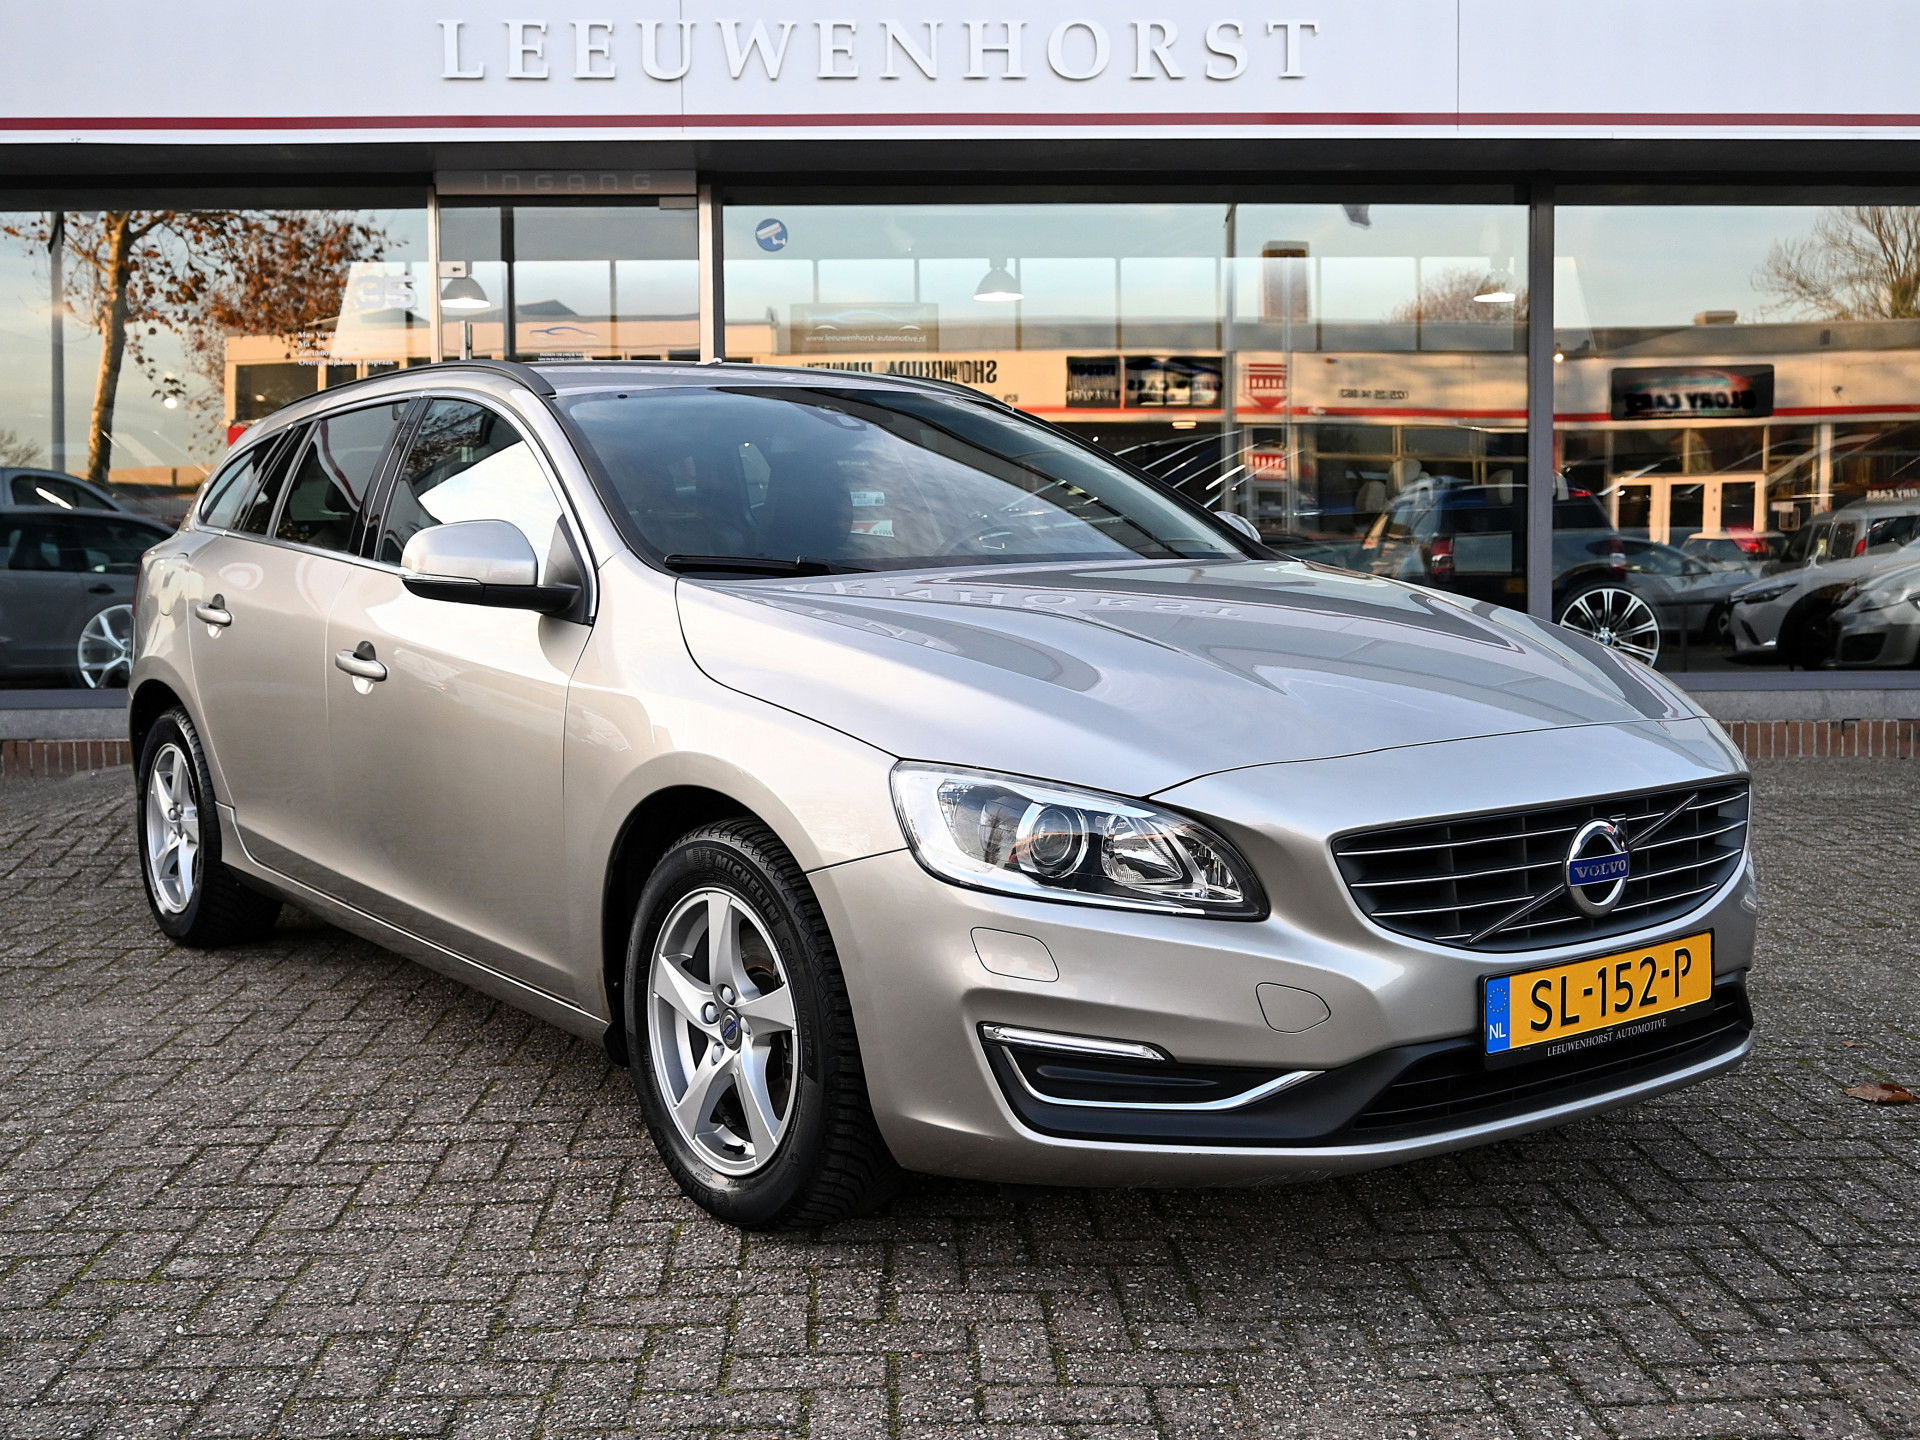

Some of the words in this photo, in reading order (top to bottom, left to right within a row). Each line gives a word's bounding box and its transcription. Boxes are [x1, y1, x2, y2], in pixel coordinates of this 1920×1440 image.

[436, 17, 1320, 82] LEEUWENHORST
[483, 174, 650, 191] INGANG
[356, 275, 417, 308] 35
[806, 334, 927, 343] www.leeuwenhorst-automotive.nl
[1574, 859, 1627, 878] VOLVO
[715, 854, 782, 927] MICHELIN
[1530, 947, 1692, 1032] SL-152-P
[1489, 1022, 1507, 1041] NL
[1547, 1031, 1614, 1057] LEEUWENHORST
[1615, 1017, 1667, 1040] AUTOMOTIVE
